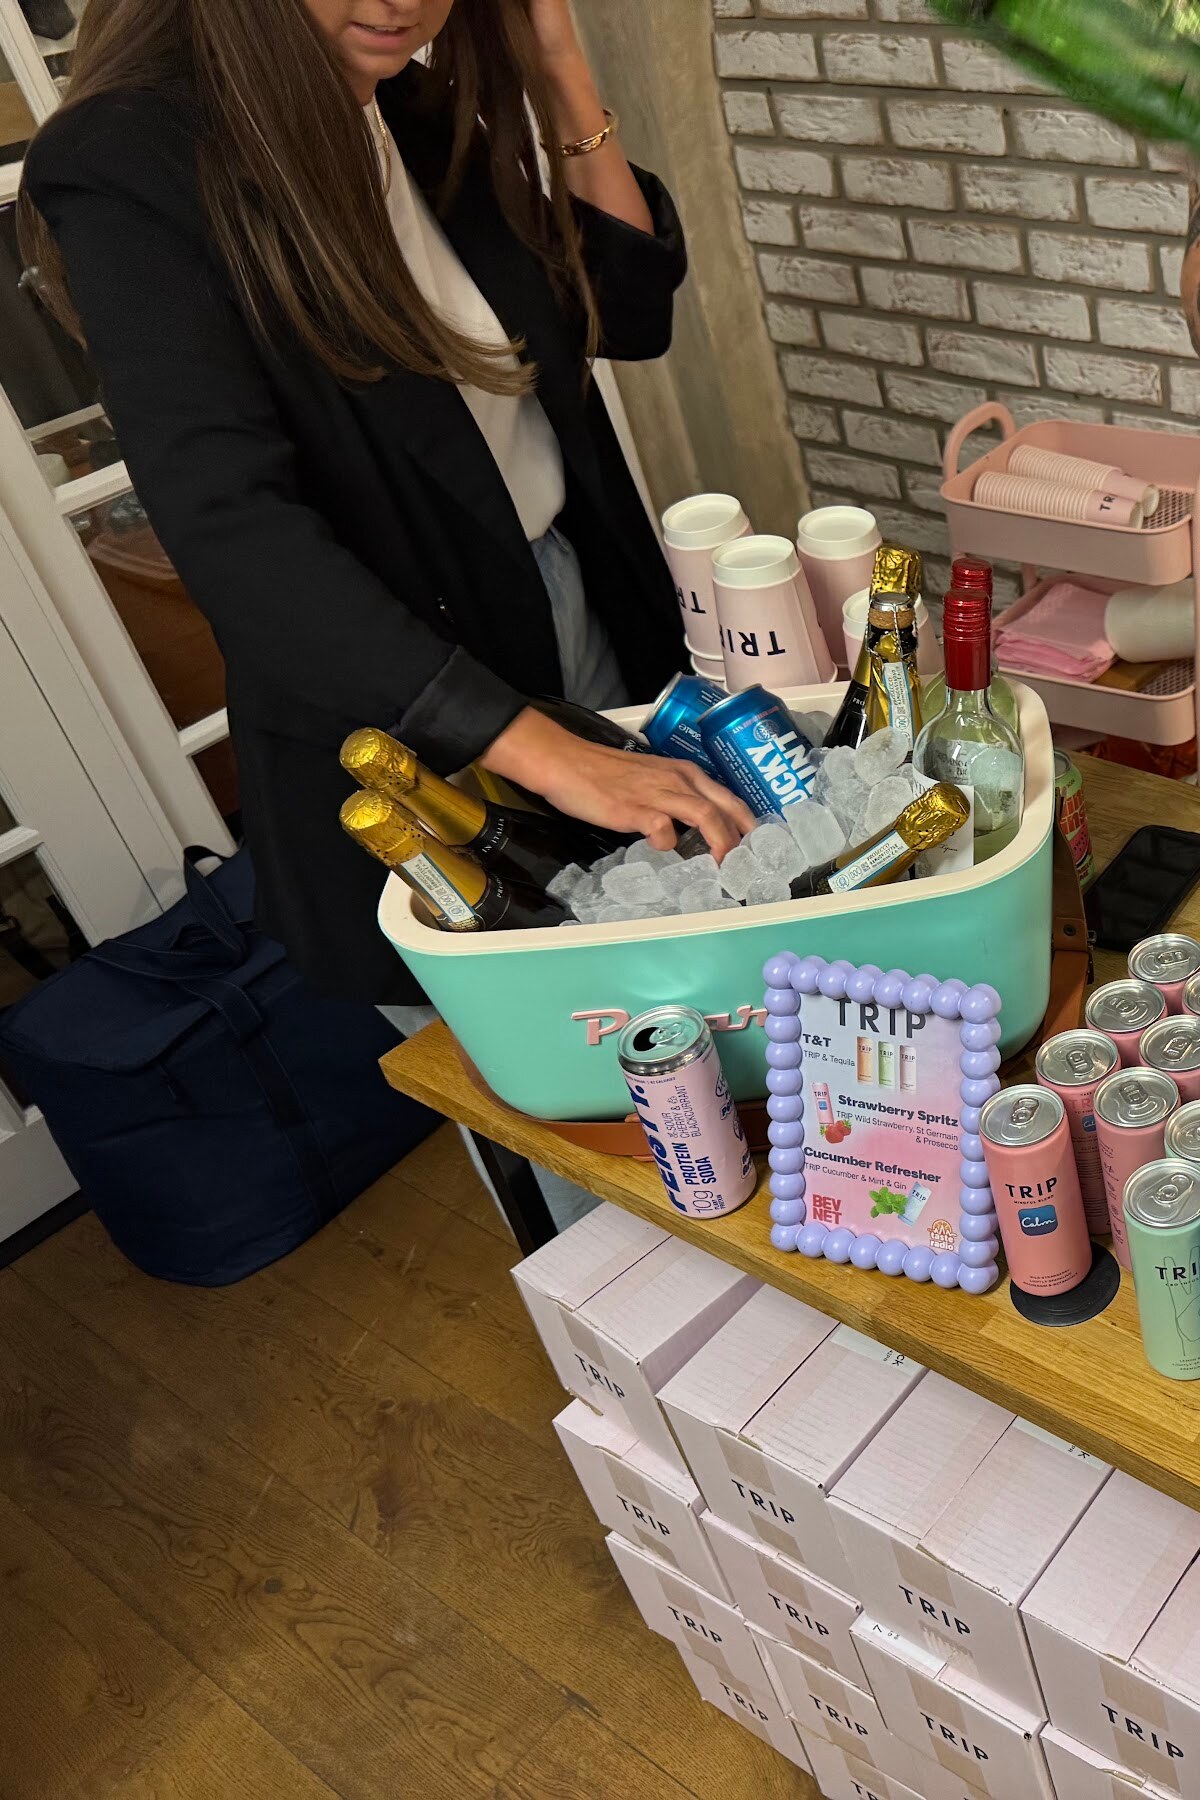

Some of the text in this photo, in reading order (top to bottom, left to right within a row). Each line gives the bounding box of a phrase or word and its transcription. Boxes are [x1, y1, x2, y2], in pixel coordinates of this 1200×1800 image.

[719, 623, 786, 657] TRI
[746, 741, 809, 806] UCKY
[836, 998, 926, 1039] TRIP
[803, 1033, 832, 1048] T&T
[804, 1050, 821, 1060] TRIP
[830, 1054, 856, 1067] Tequila
[662, 1112, 675, 1134] SOUR
[674, 1110, 686, 1139] CHERRY
[675, 1085, 702, 1138] BLACKCURRANT
[836, 1110, 853, 1119] TRIP
[854, 1114, 871, 1124] Wild
[916, 1126, 925, 1135] St
[926, 1128, 958, 1142] Germain
[838, 1094, 959, 1127] Strawberry Spritz
[915, 1135, 959, 1151] & Prosecco
[672, 1142, 700, 1185] PROTEIN
[697, 1156, 717, 1184] SODA
[803, 1146, 942, 1183] Cucumber Refresher
[804, 1162, 907, 1190] TRIP Cucumber & Mint & Gin
[692, 1190, 714, 1214] 10g
[812, 1194, 842, 1211] BEV
[1005, 1177, 1058, 1199] TRIP
[812, 1209, 842, 1225] NET
[1020, 1217, 1058, 1229] Calm
[929, 1240, 954, 1251] radio
[930, 1231, 954, 1243] taste
[575, 1353, 625, 1398] TRIP
[617, 1495, 670, 1536] TRIP
[731, 1479, 795, 1524] TRIP
[667, 1606, 722, 1644] TRIP
[768, 1592, 829, 1636] TRIP
[898, 1585, 971, 1635] TRIP
[719, 1682, 769, 1722] TRIP
[809, 1694, 868, 1736] TRIP
[920, 1712, 989, 1761] TRIP
[1101, 1703, 1185, 1759] TRIP
